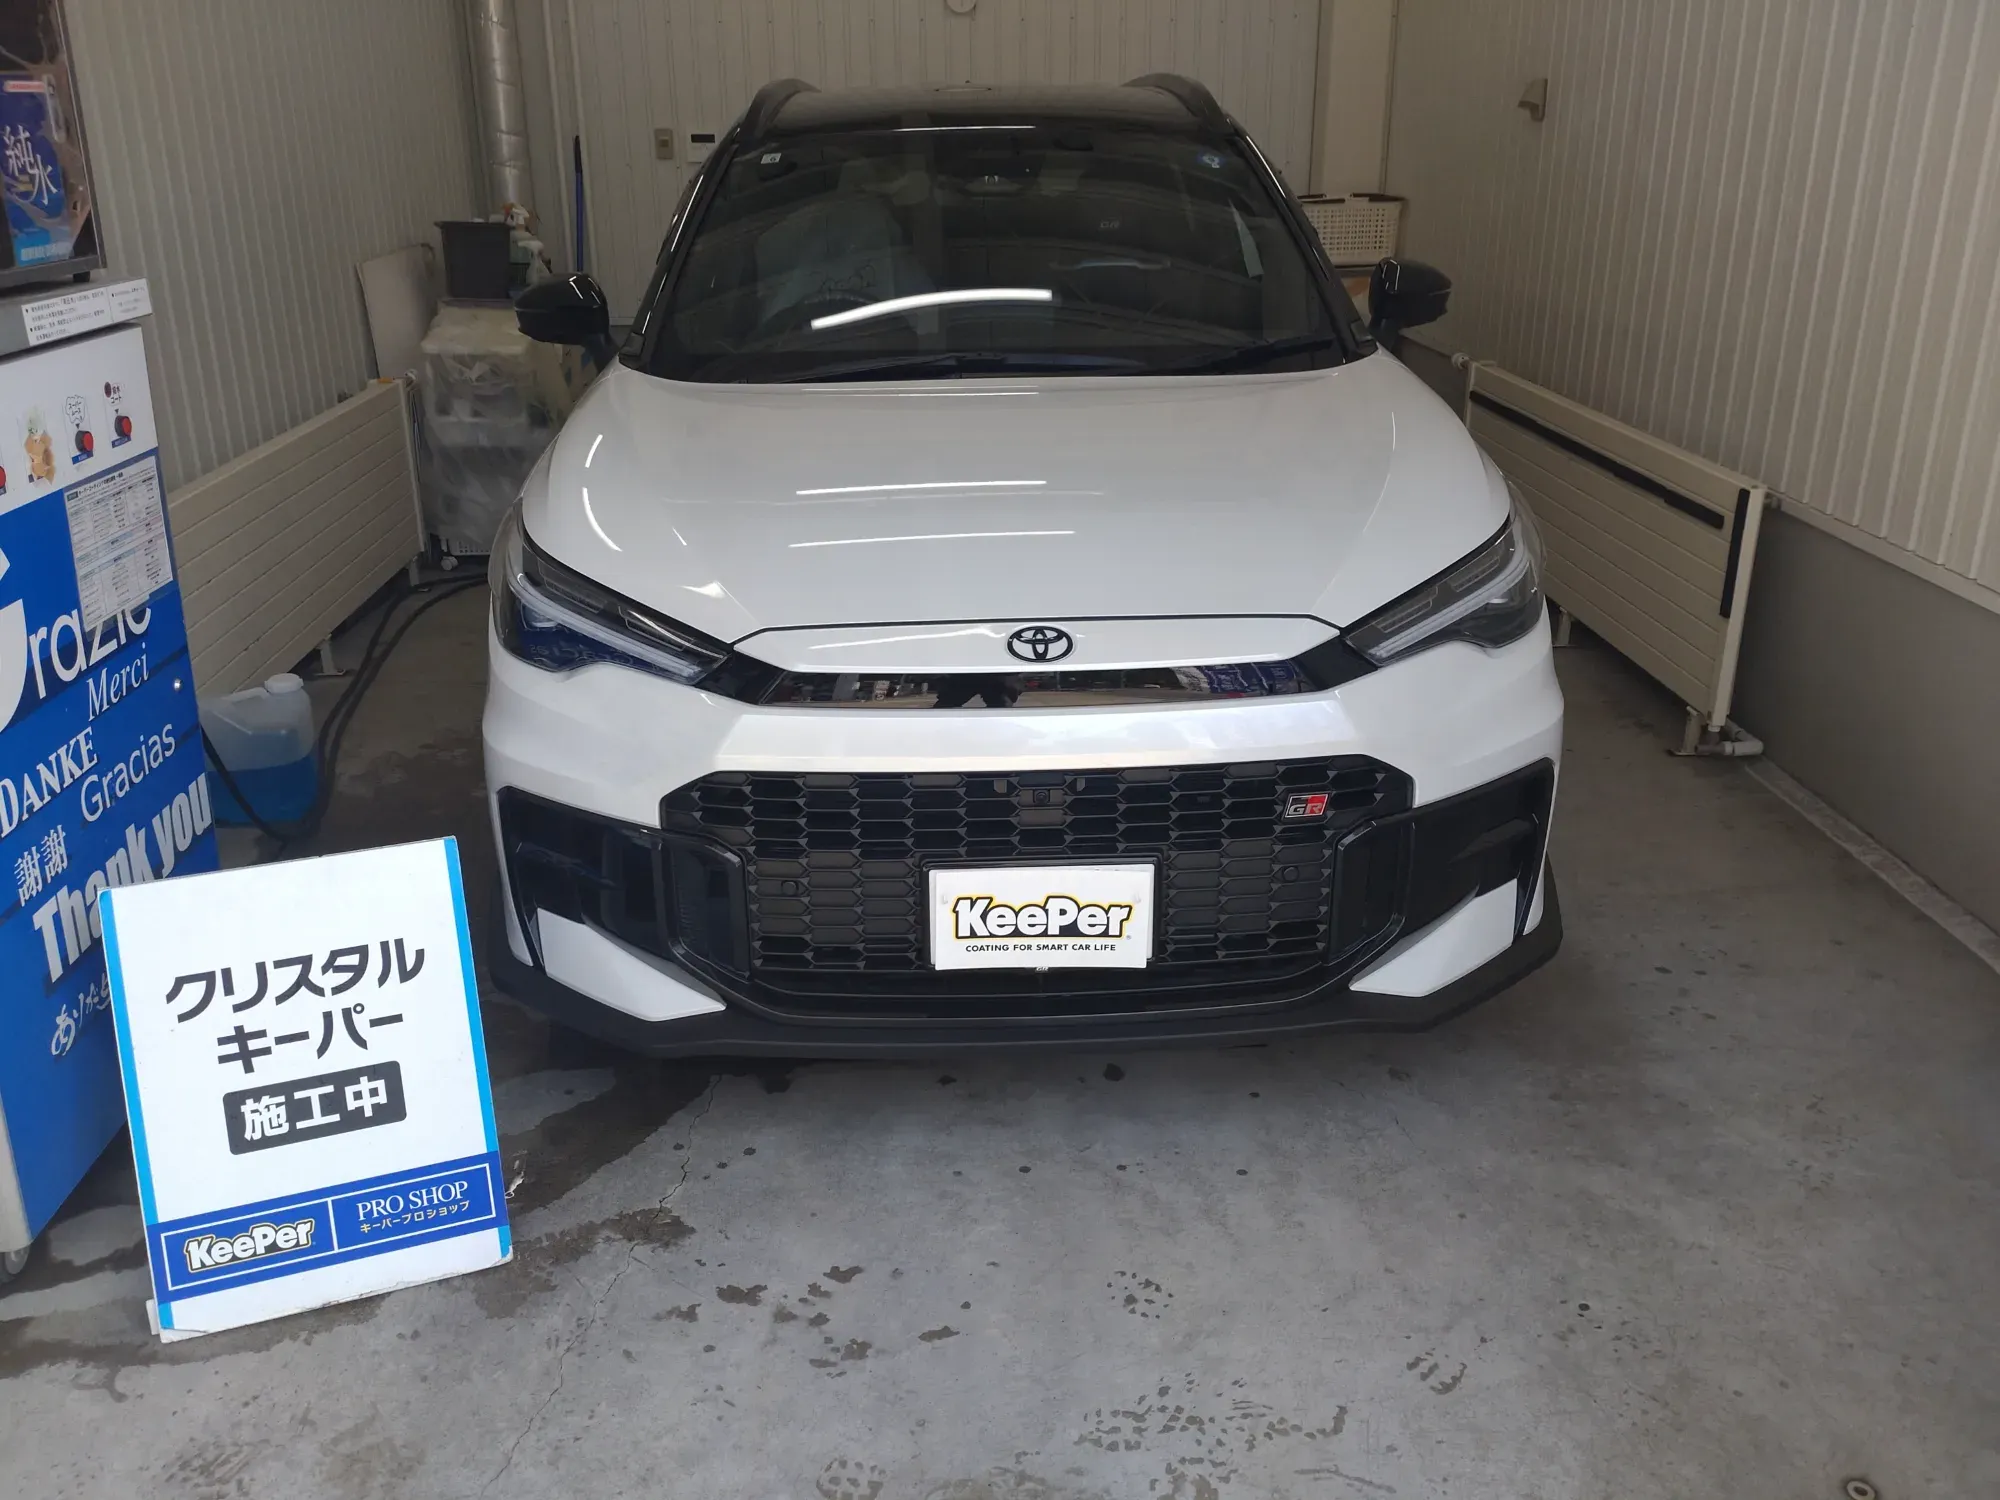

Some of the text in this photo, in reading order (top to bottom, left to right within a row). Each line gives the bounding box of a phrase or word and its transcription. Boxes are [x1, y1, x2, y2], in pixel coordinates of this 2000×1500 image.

[3, 124, 58, 205] 純水
[86, 641, 149, 721] Merci
[0, 726, 98, 838] DANKE
[81, 723, 175, 822] Gracias
[1287, 800, 1325, 816] GR
[152, 773, 213, 879] you
[14, 824, 68, 907] 謝謝
[953, 894, 1133, 940] KeePer
[965, 943, 1116, 952] COATING FOR SMART CAR LIFE
[165, 938, 425, 1024] クリスタル
[217, 1002, 403, 1074] キーパー
[240, 1075, 388, 1143] 施工中
[356, 1180, 468, 1221] PRO SHOP
[360, 1200, 470, 1233] キーパープロショップ
[185, 1219, 315, 1272] KeePer
